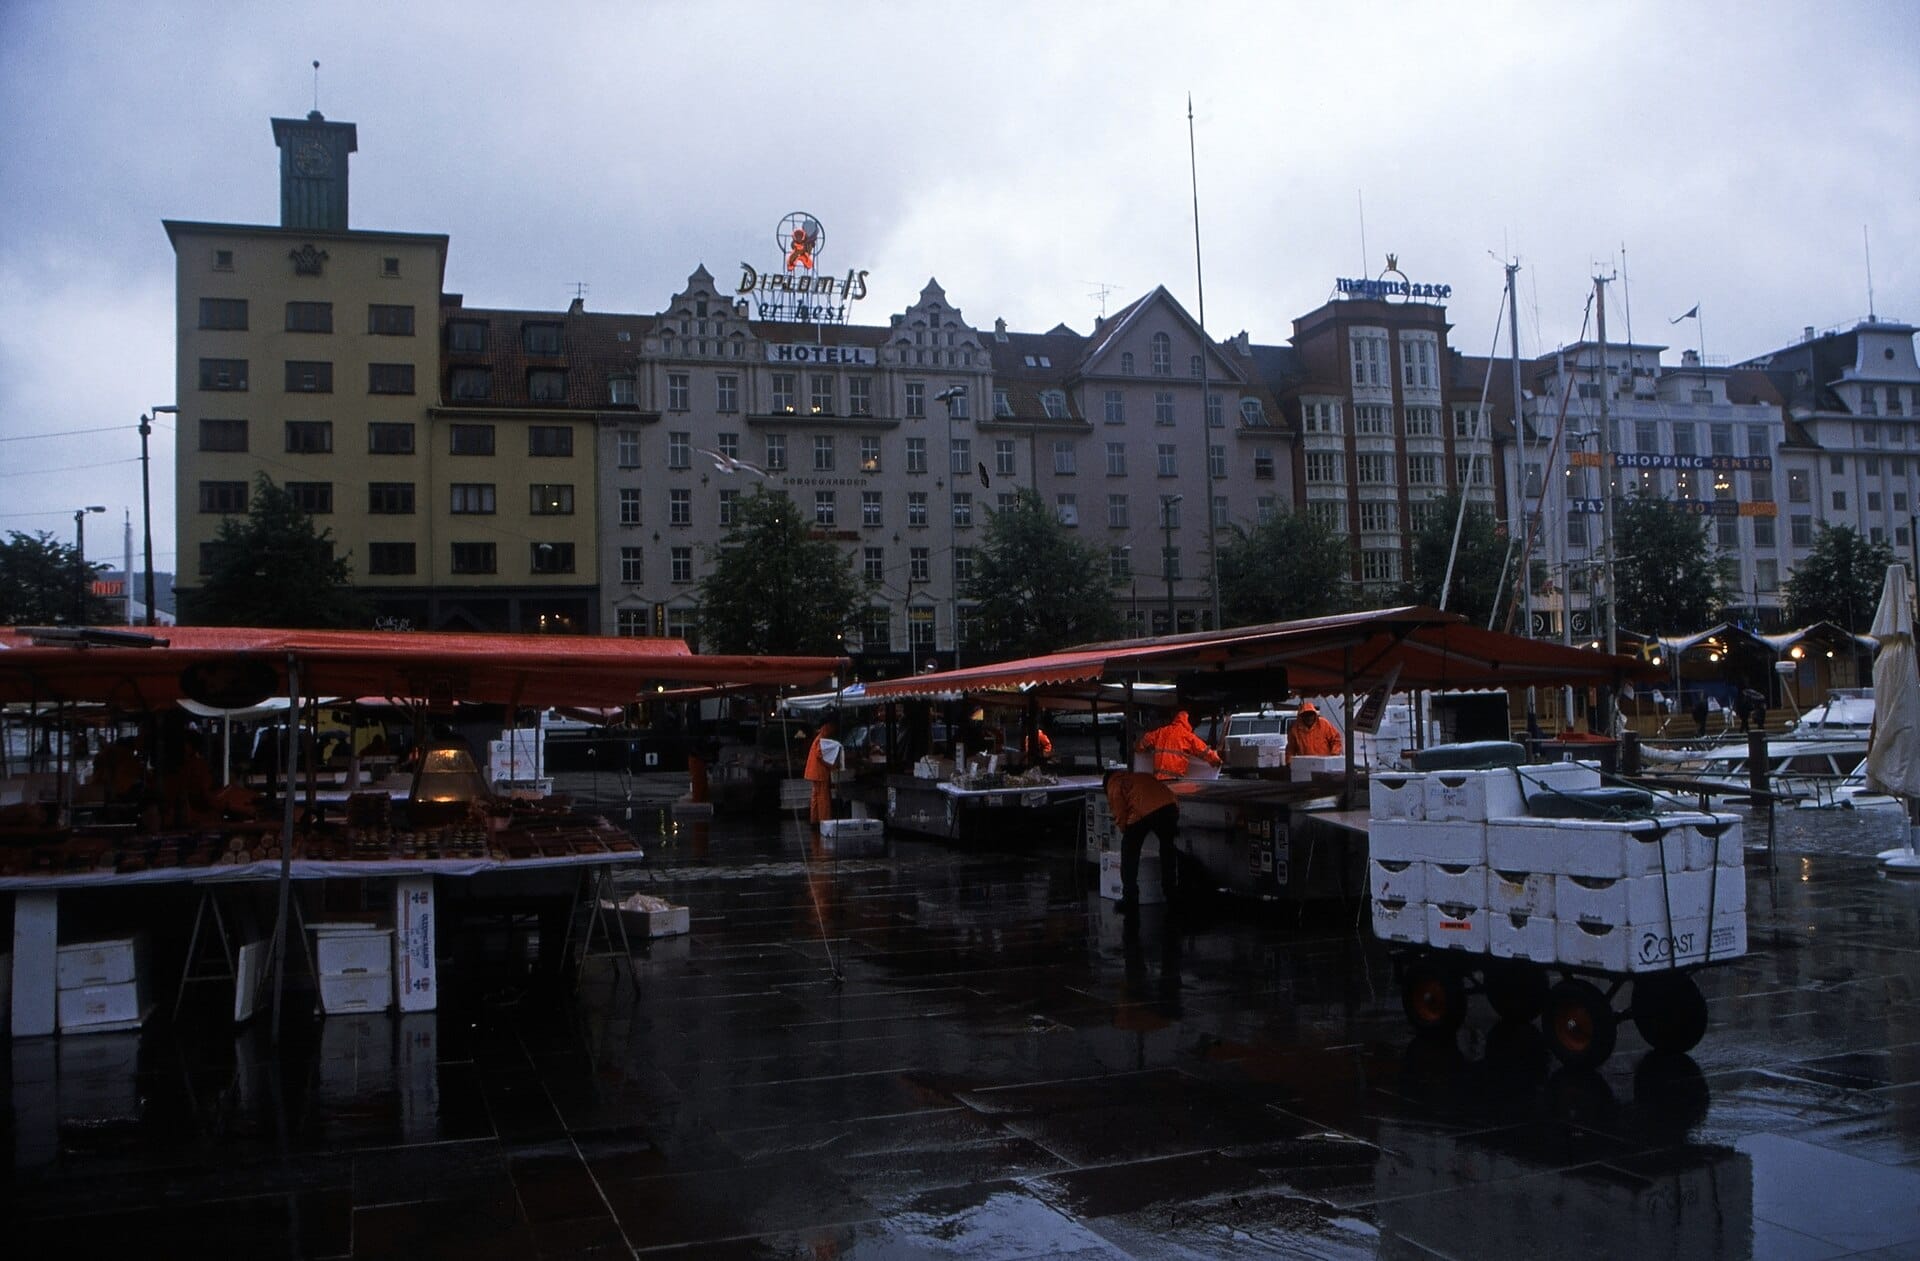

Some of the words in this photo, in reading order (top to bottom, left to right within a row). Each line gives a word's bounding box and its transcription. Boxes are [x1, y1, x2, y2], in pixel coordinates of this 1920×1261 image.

[778, 345, 866, 363] HOTELL
[1616, 453, 1704, 469] SHOPPING
[1712, 457, 1771, 471] SENTER
